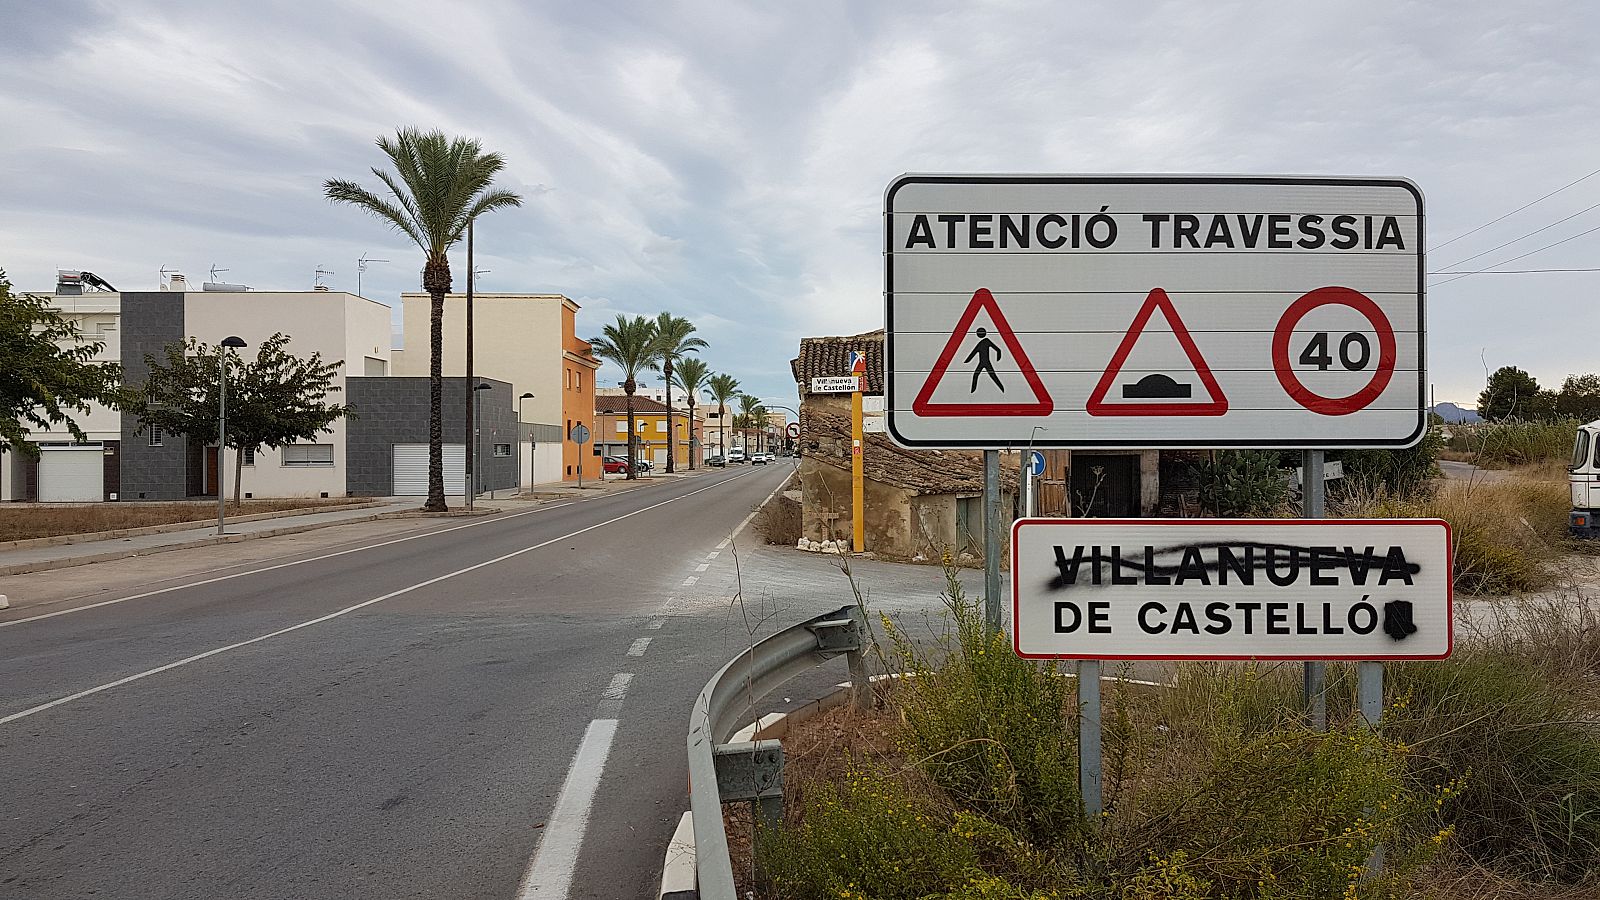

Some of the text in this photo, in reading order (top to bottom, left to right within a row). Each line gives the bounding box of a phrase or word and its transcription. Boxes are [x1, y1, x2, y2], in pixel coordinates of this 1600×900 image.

[905, 205, 1406, 251] ATENCIÓ TRAVESSIA
[1298, 331, 1372, 373] 40
[1052, 545, 1415, 587] VILLANUEVA
[1053, 595, 1414, 636] DE CASTELLÓ
